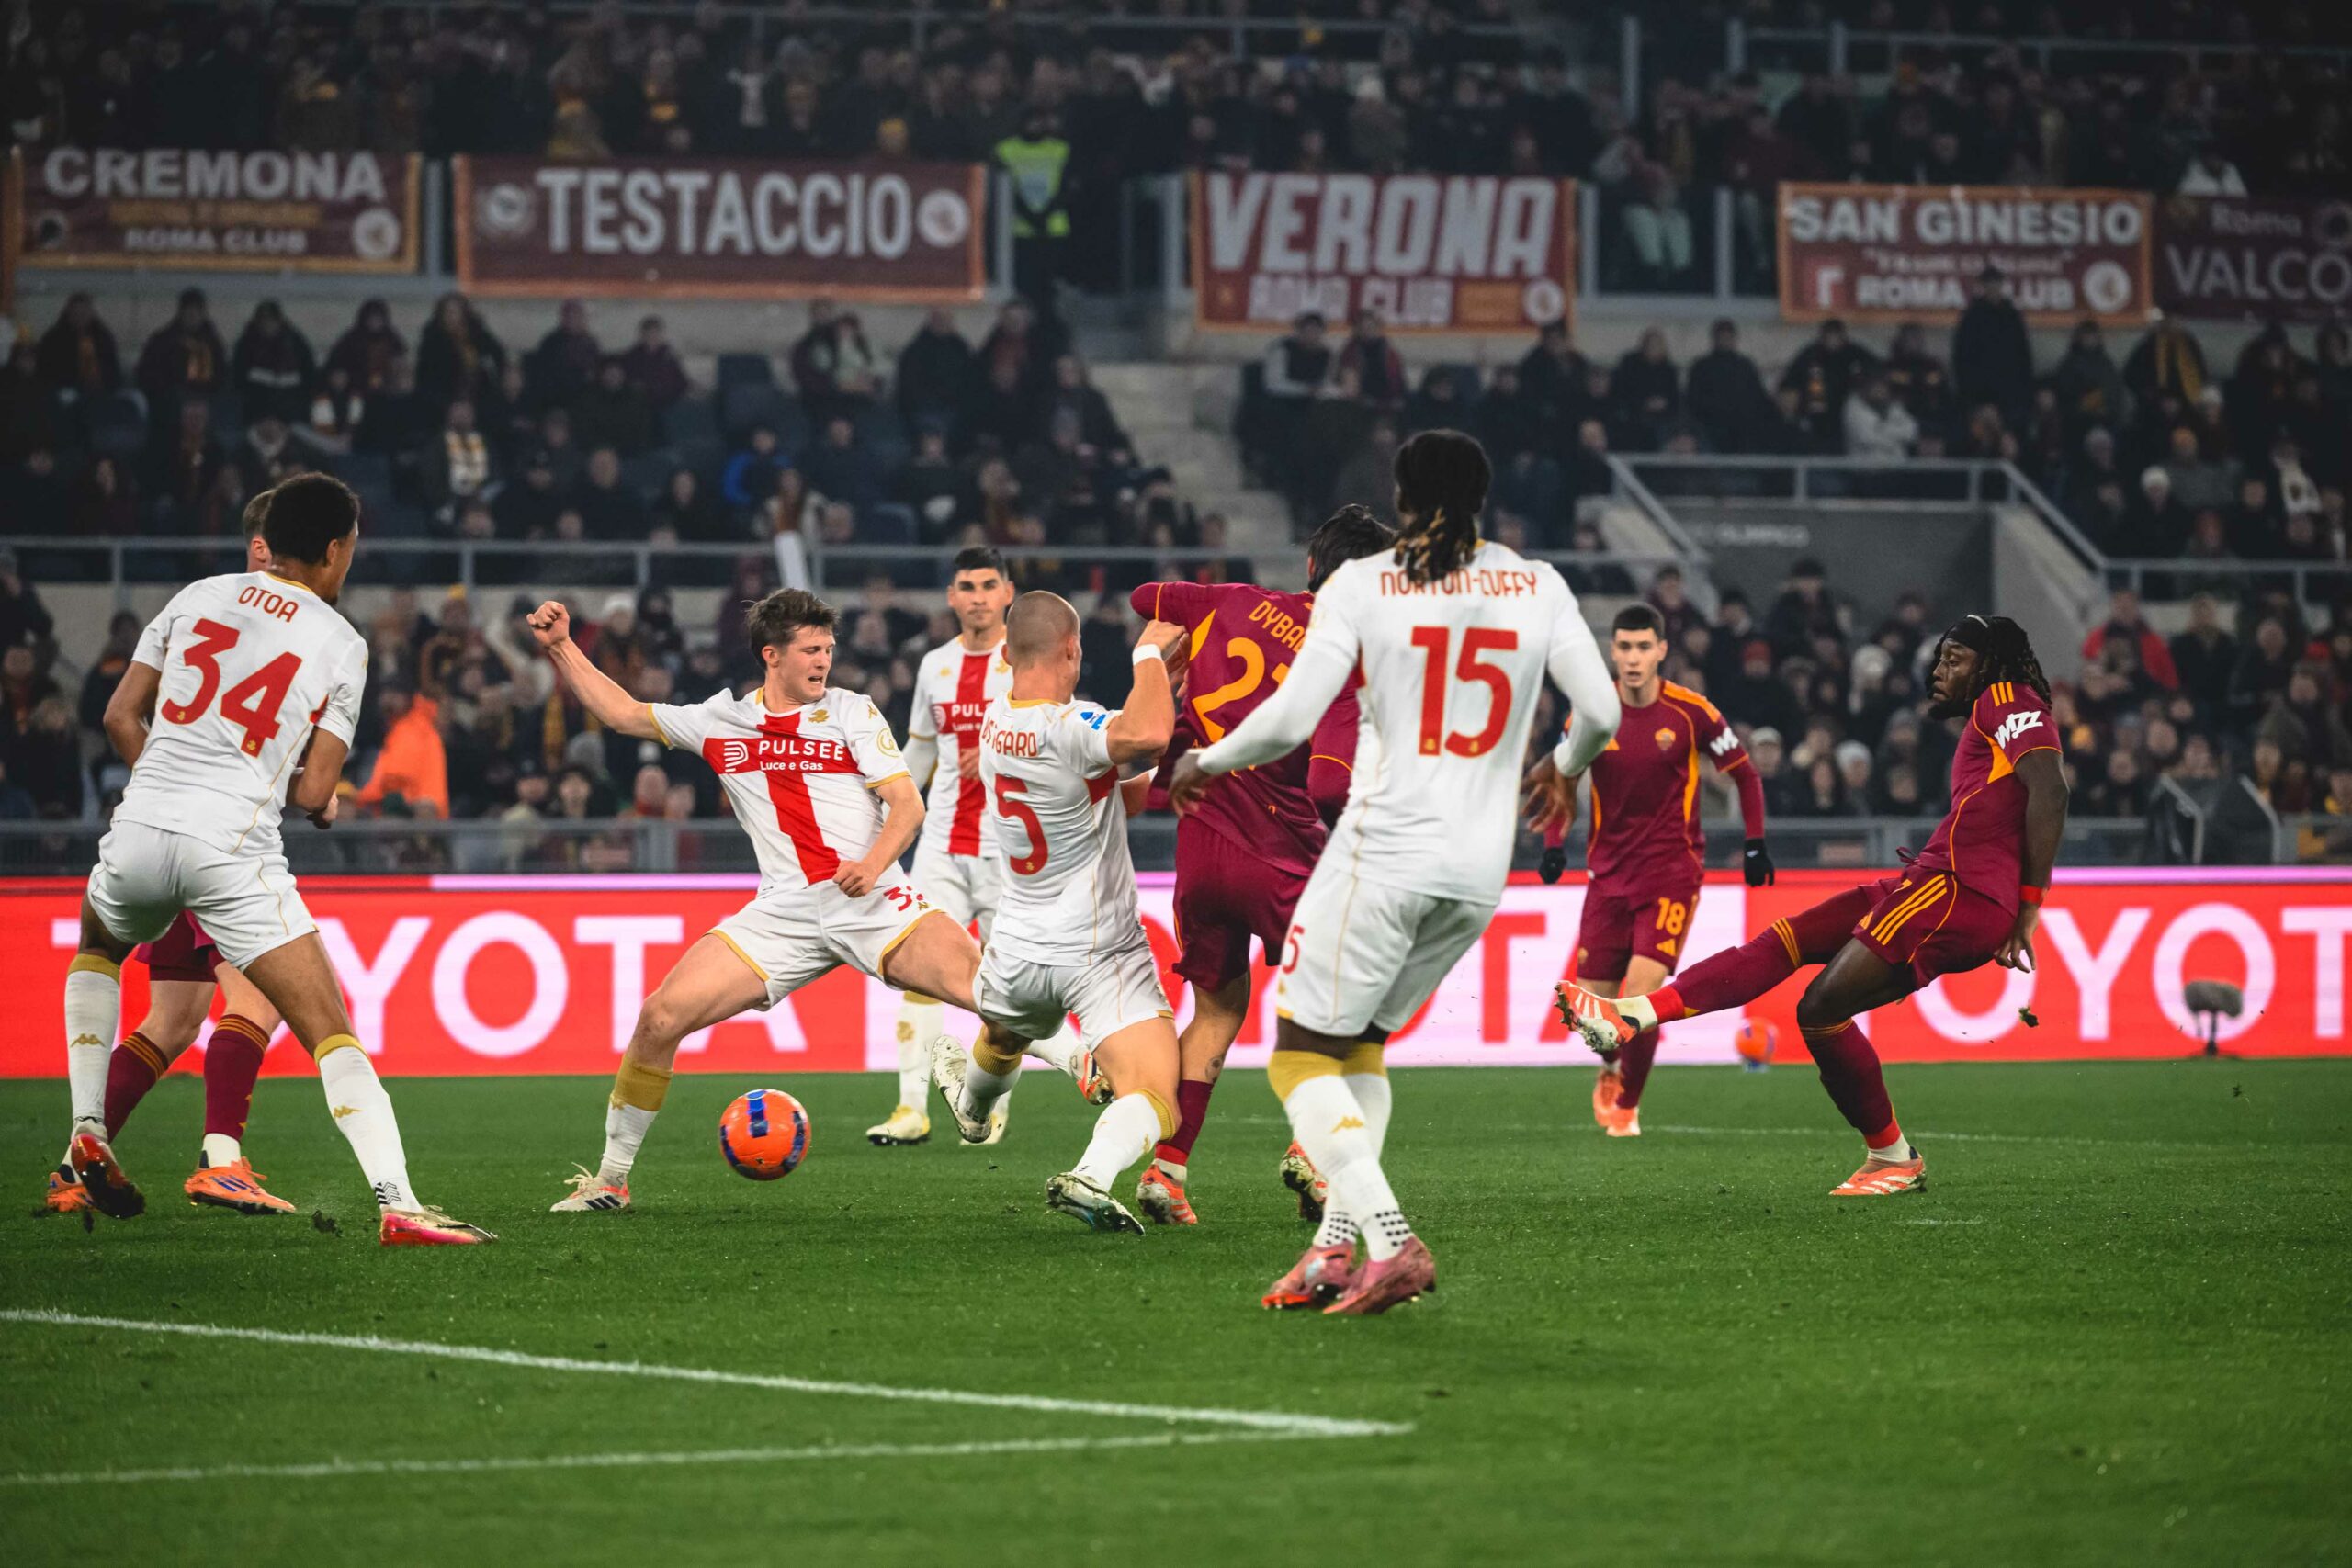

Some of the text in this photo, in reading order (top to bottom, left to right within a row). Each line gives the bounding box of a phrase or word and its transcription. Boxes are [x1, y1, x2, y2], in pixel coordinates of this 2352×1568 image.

[42, 147, 386, 203] CREMONA
[536, 167, 912, 260] TESTACCIO
[1206, 173, 1559, 277] VERONA
[1789, 197, 2143, 246] SAN GINESIO
[1992, 277, 2075, 310] LUB
[238, 586, 299, 623] OTOA
[161, 617, 302, 758] 34
[1411, 626, 1519, 758] 15
[952, 703, 985, 717] PUL
[758, 739, 844, 761] PULSEE
[759, 760, 824, 771] Luce e Gas
[995, 773, 1049, 876] 5
[883, 885, 924, 912] 3
[1656, 897, 1686, 935] 18
